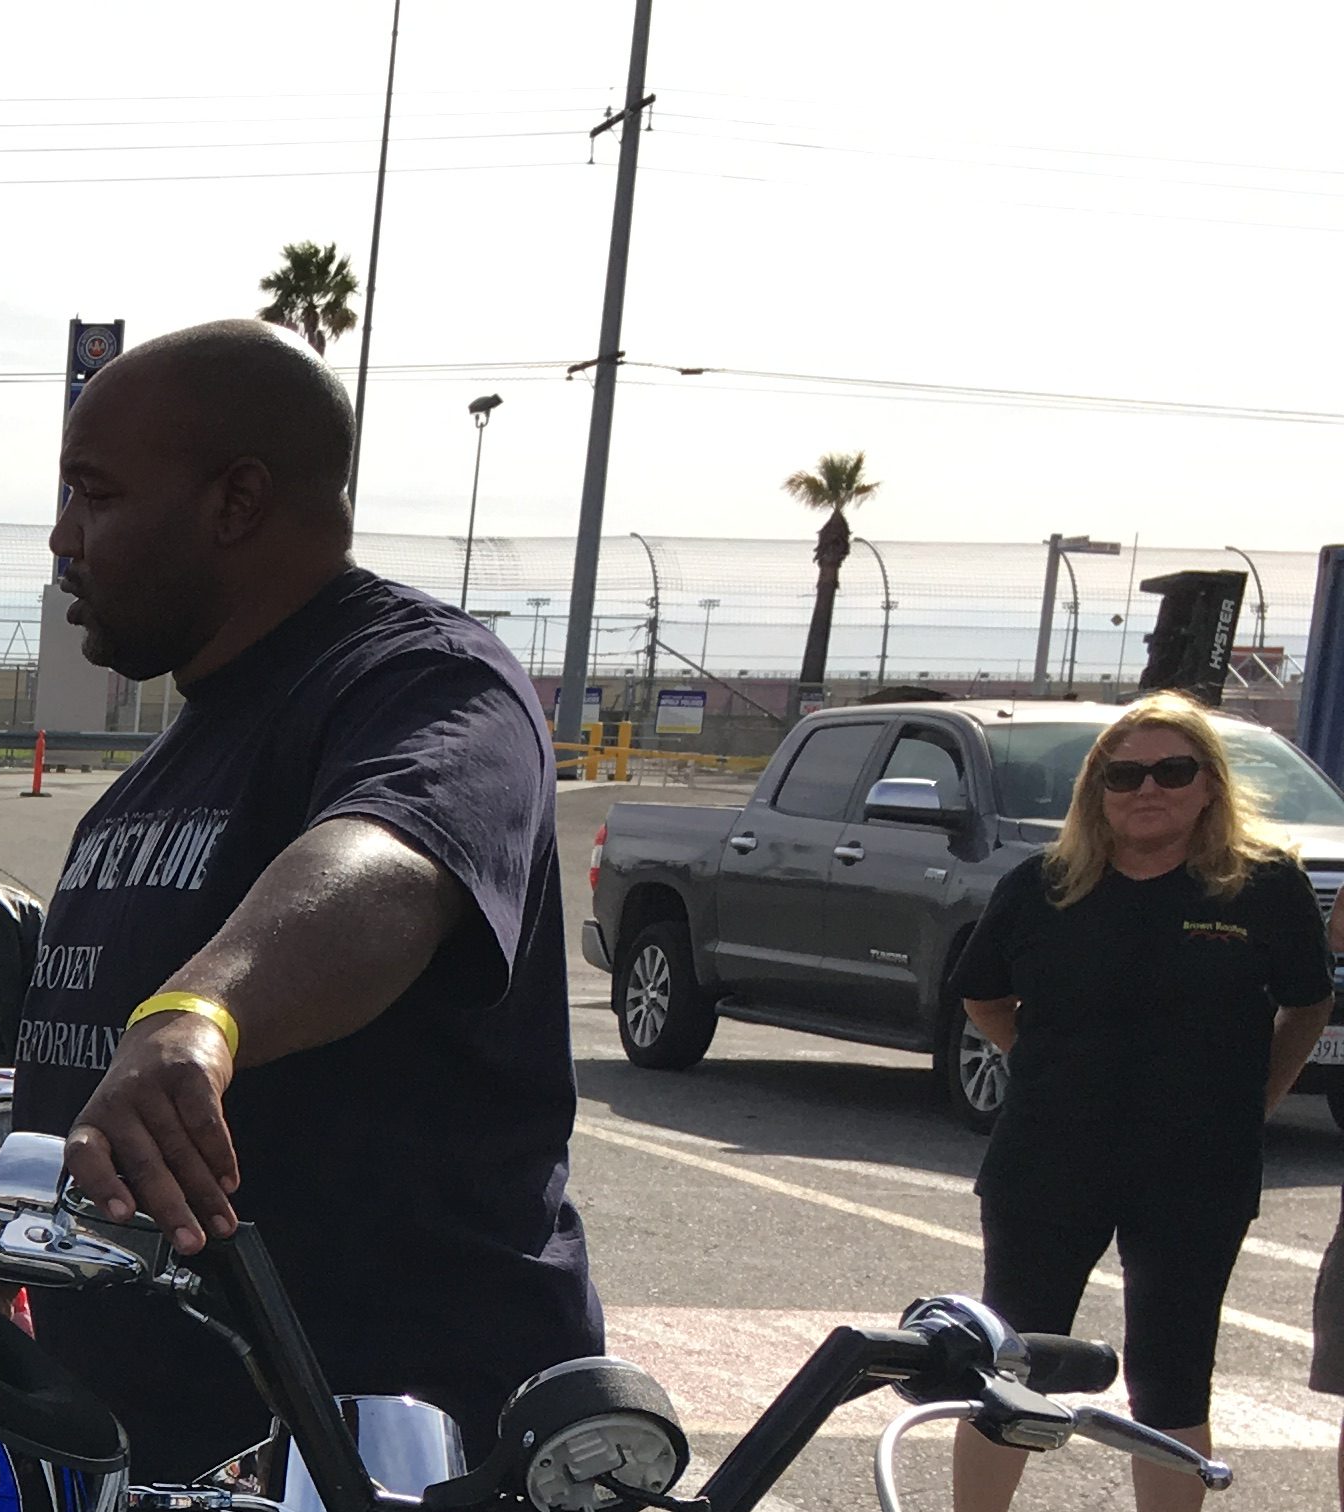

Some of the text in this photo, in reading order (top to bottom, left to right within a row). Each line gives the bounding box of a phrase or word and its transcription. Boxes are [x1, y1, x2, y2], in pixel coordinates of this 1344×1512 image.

[1208, 599, 1235, 670] HYSTER
[146, 815, 229, 890] LOVE
[1183, 921, 1213, 930] Brown
[869, 949, 908, 964] TUNDRA
